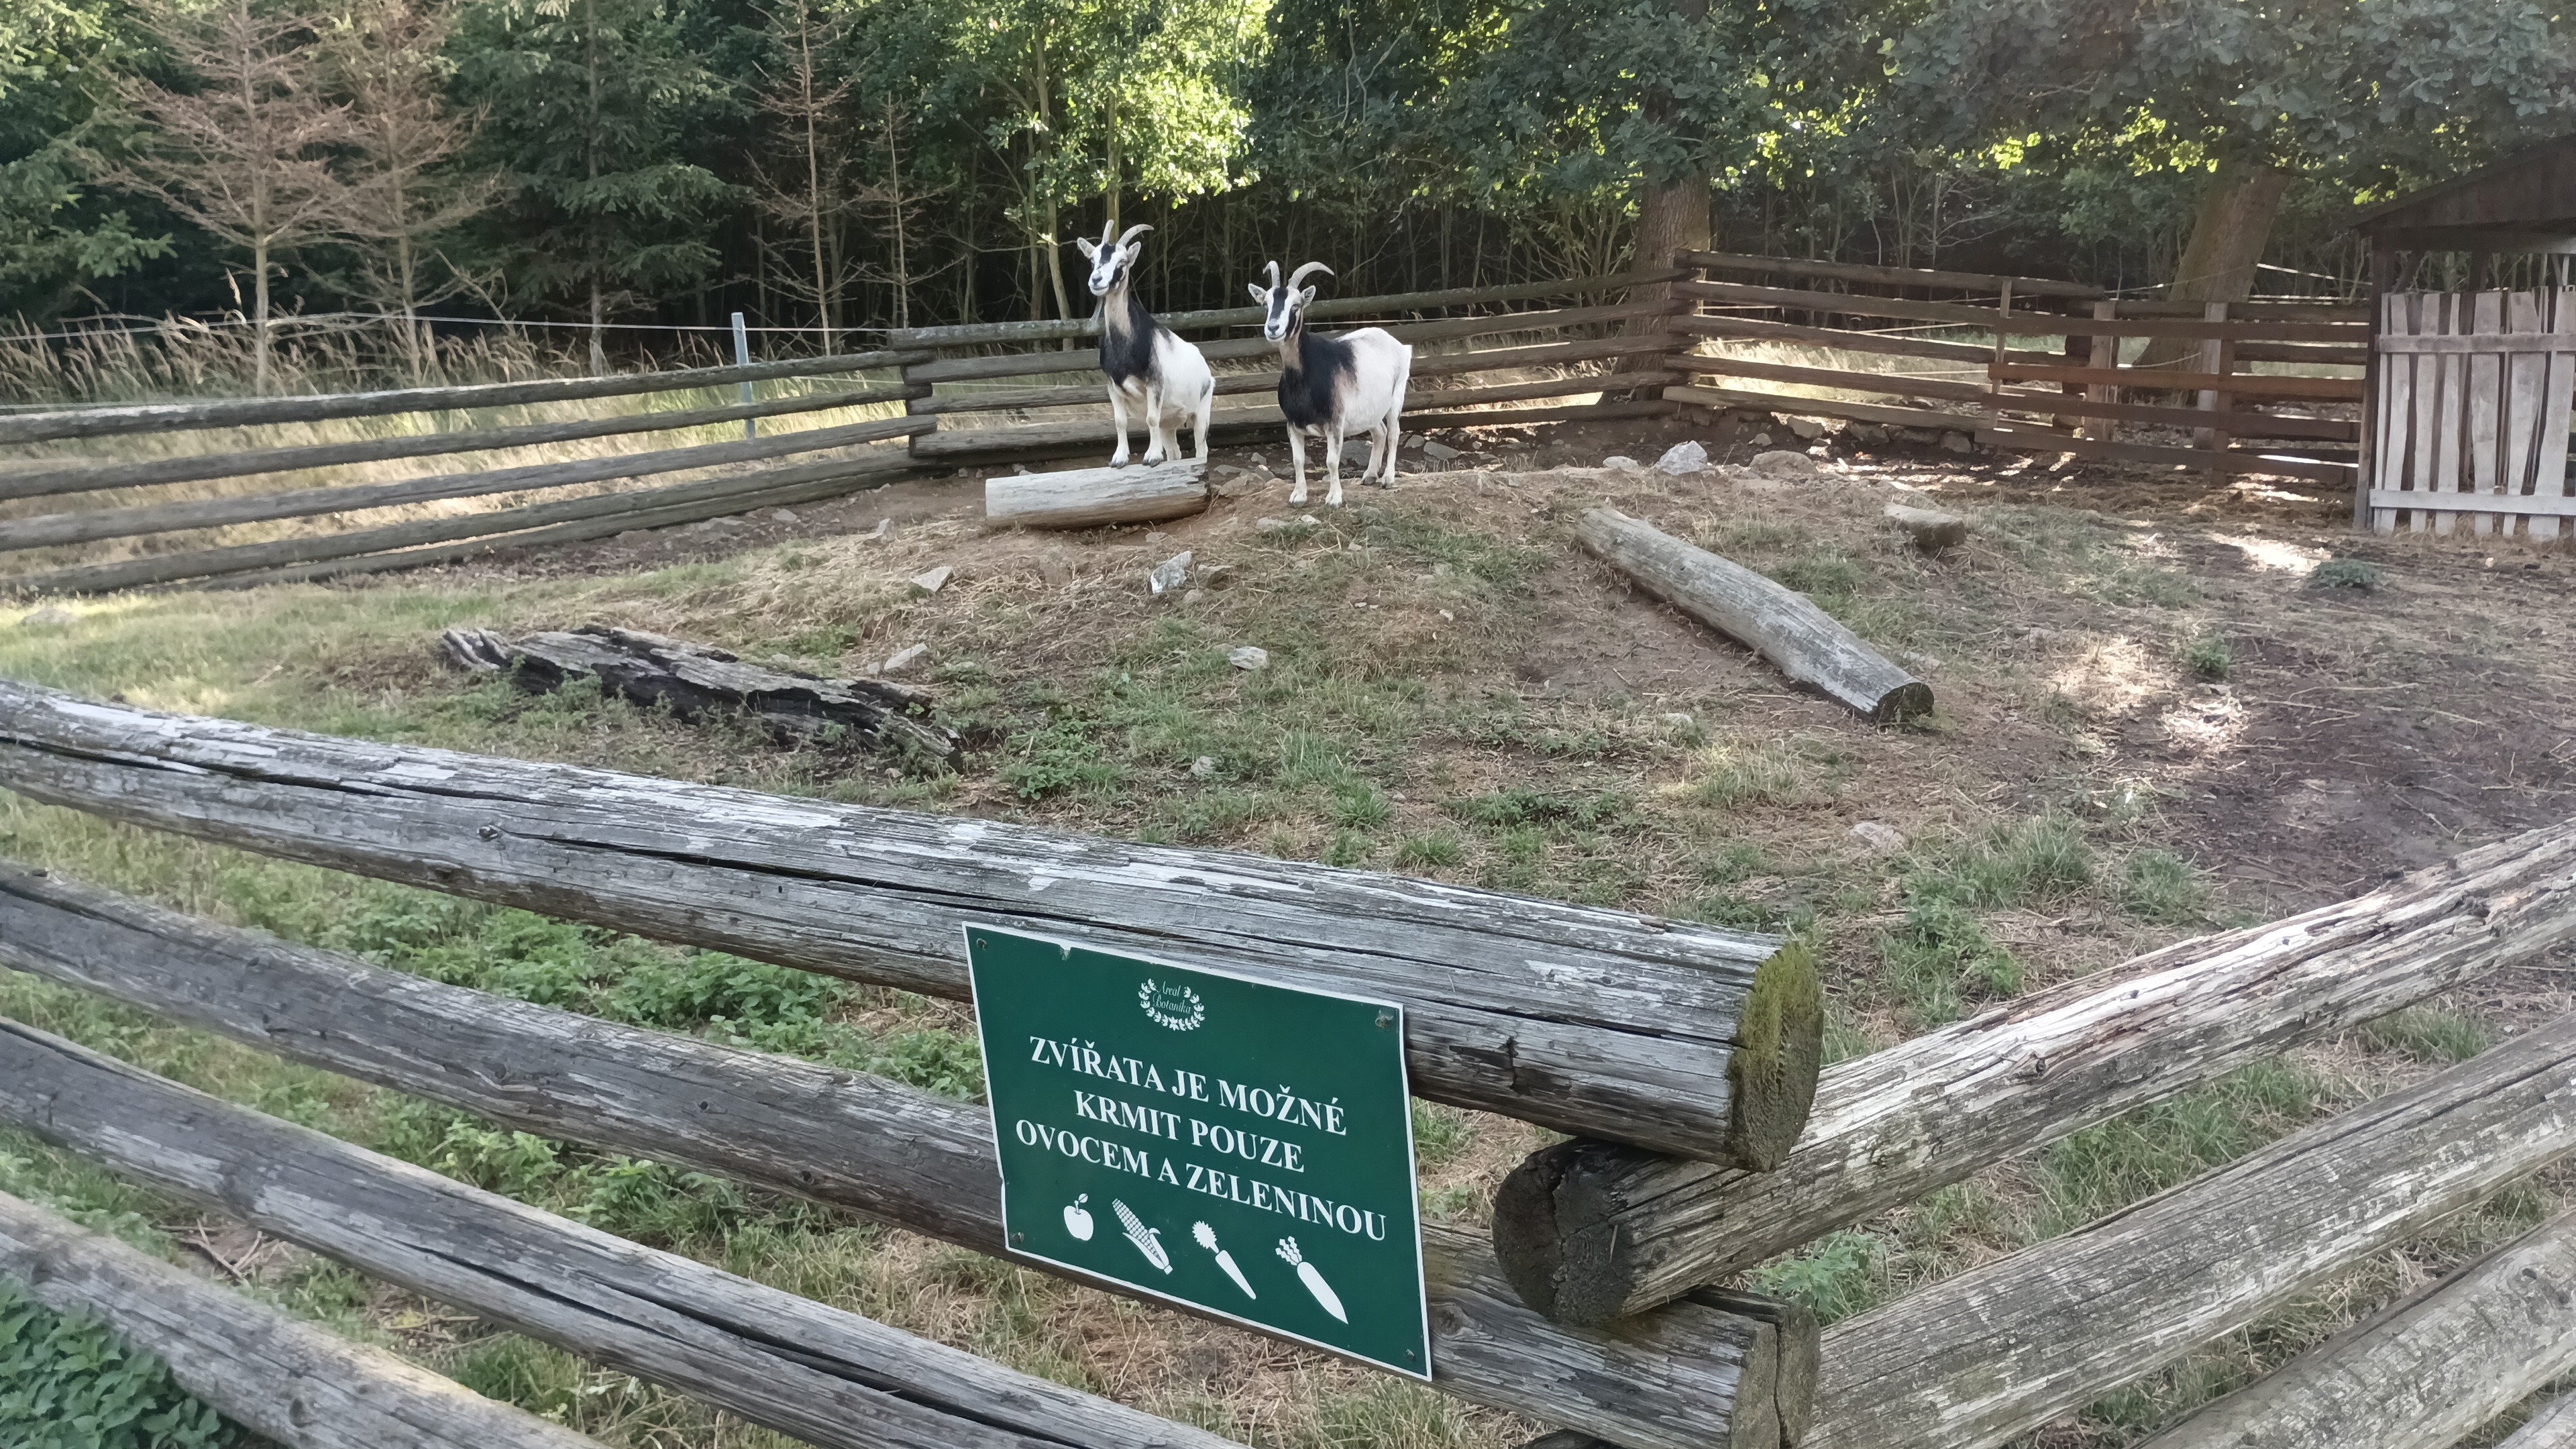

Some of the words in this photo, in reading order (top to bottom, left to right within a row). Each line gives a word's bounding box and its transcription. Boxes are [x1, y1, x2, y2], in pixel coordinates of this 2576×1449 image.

[1030, 1036, 1166, 1092] ZVÍŘATA
[1171, 1069, 1209, 1102] JE
[1218, 1079, 1346, 1136] MOŽNÉ
[1074, 1090, 1181, 1140] KRMIT
[1189, 1118, 1304, 1173] POUZE
[1016, 1119, 1151, 1178] OVOCEM
[1157, 1157, 1180, 1185] A
[1186, 1163, 1386, 1241] ZELENINOU
